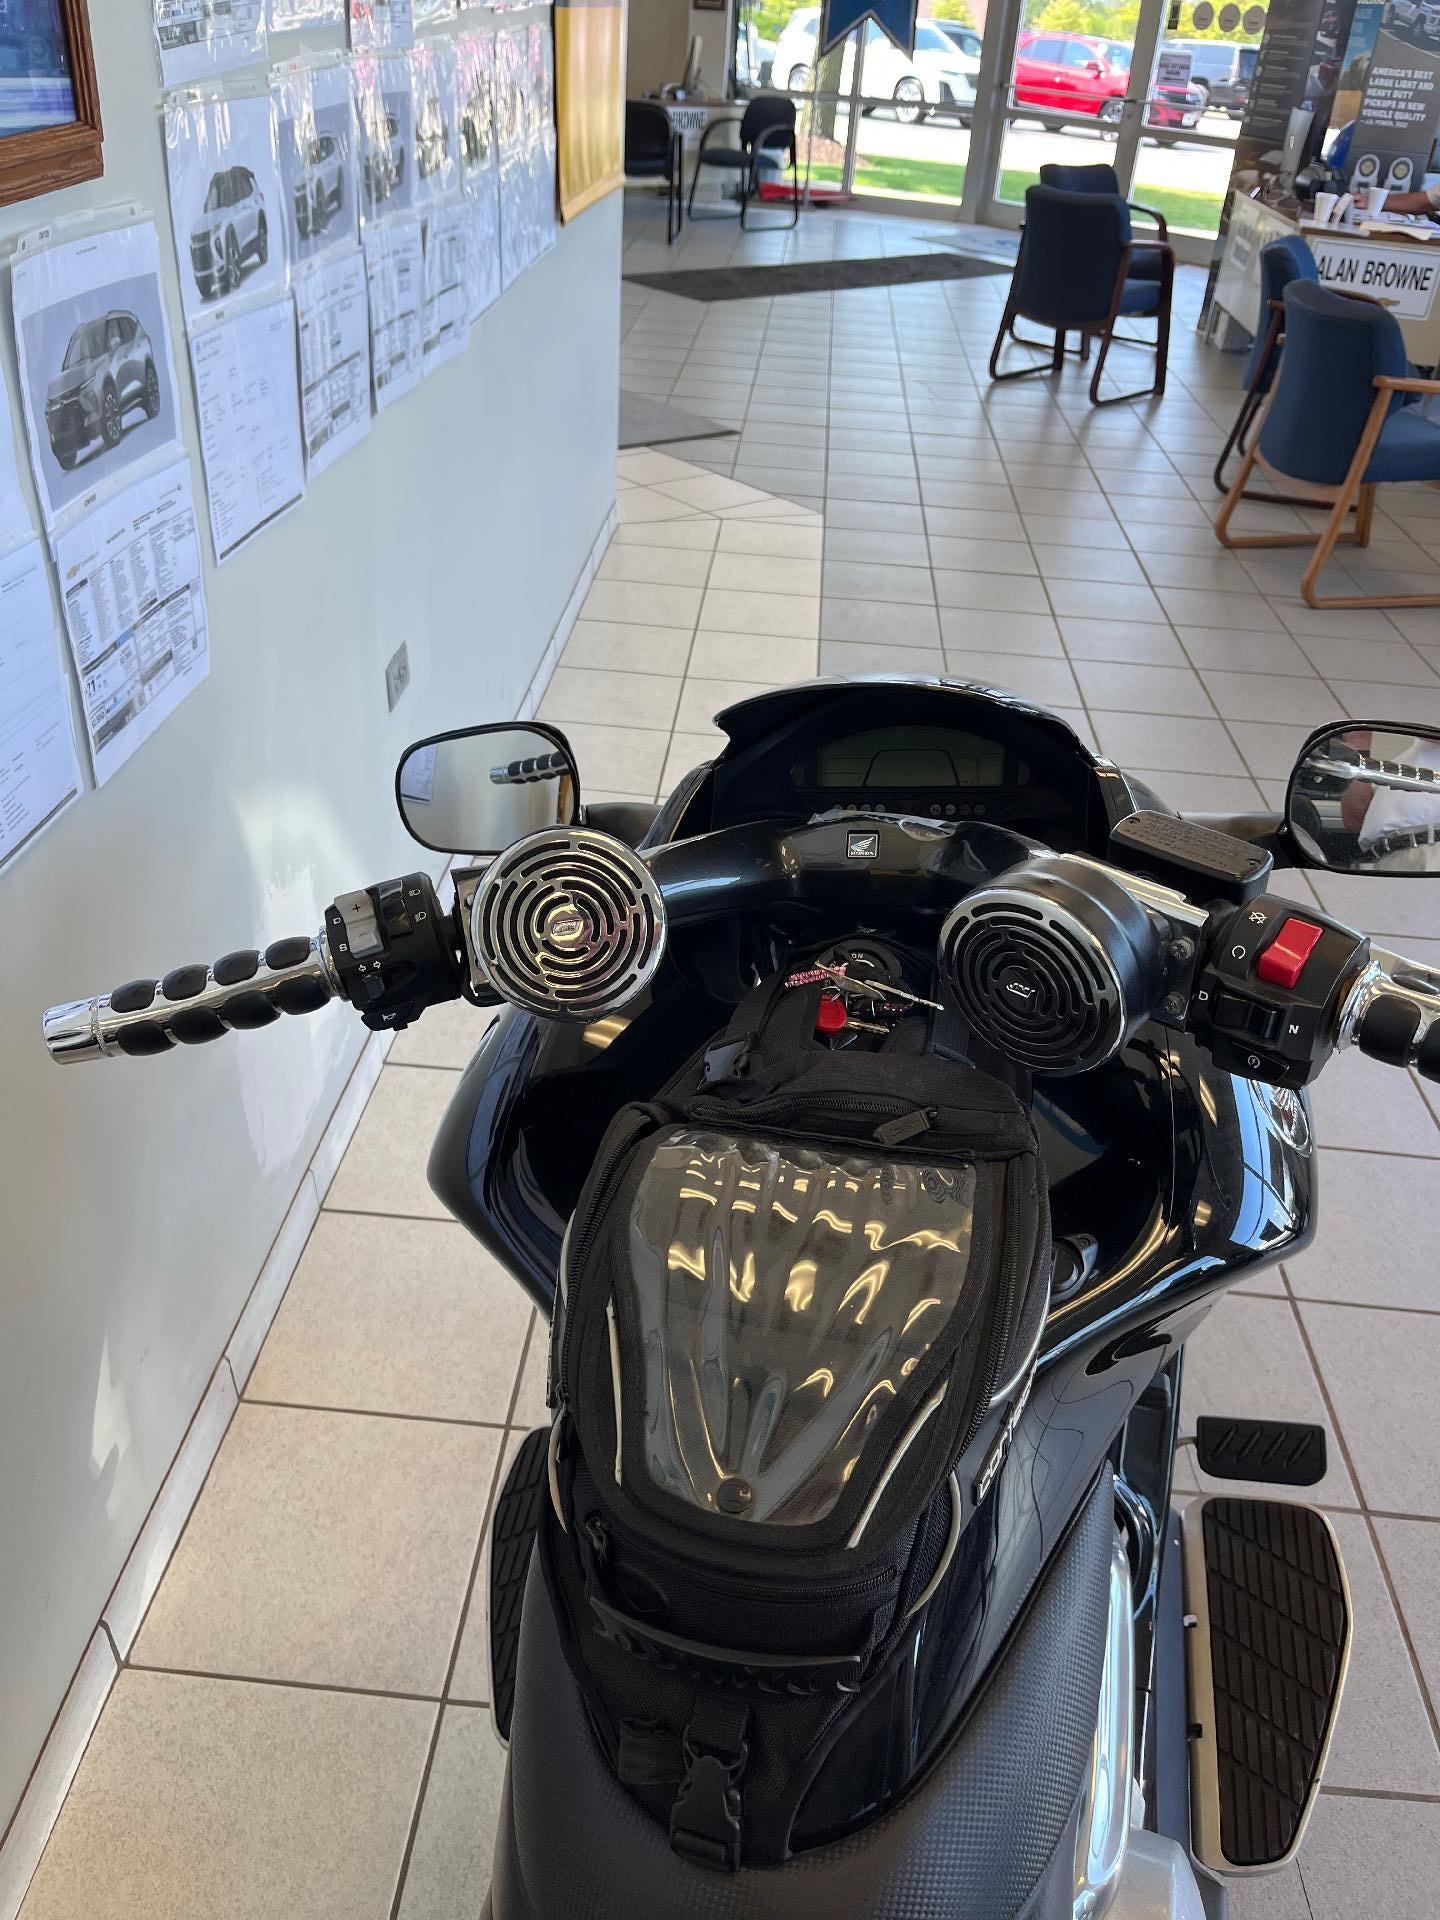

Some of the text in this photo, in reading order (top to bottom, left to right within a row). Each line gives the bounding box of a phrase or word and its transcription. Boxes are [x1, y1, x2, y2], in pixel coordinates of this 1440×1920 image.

[1372, 67, 1434, 80] AMERICA'S BEST
[1366, 87, 1392, 98] HEAVY
[1363, 98, 1397, 109] PICKUPS
[1361, 109, 1427, 122] VEHICLE QUALITY
[1318, 255, 1434, 291] ALAN BROWNE
[333, 917, 342, 925] D
[339, 943, 348, 952] S
[1198, 990, 1209, 1001] D
[1288, 1024, 1300, 1035] N
